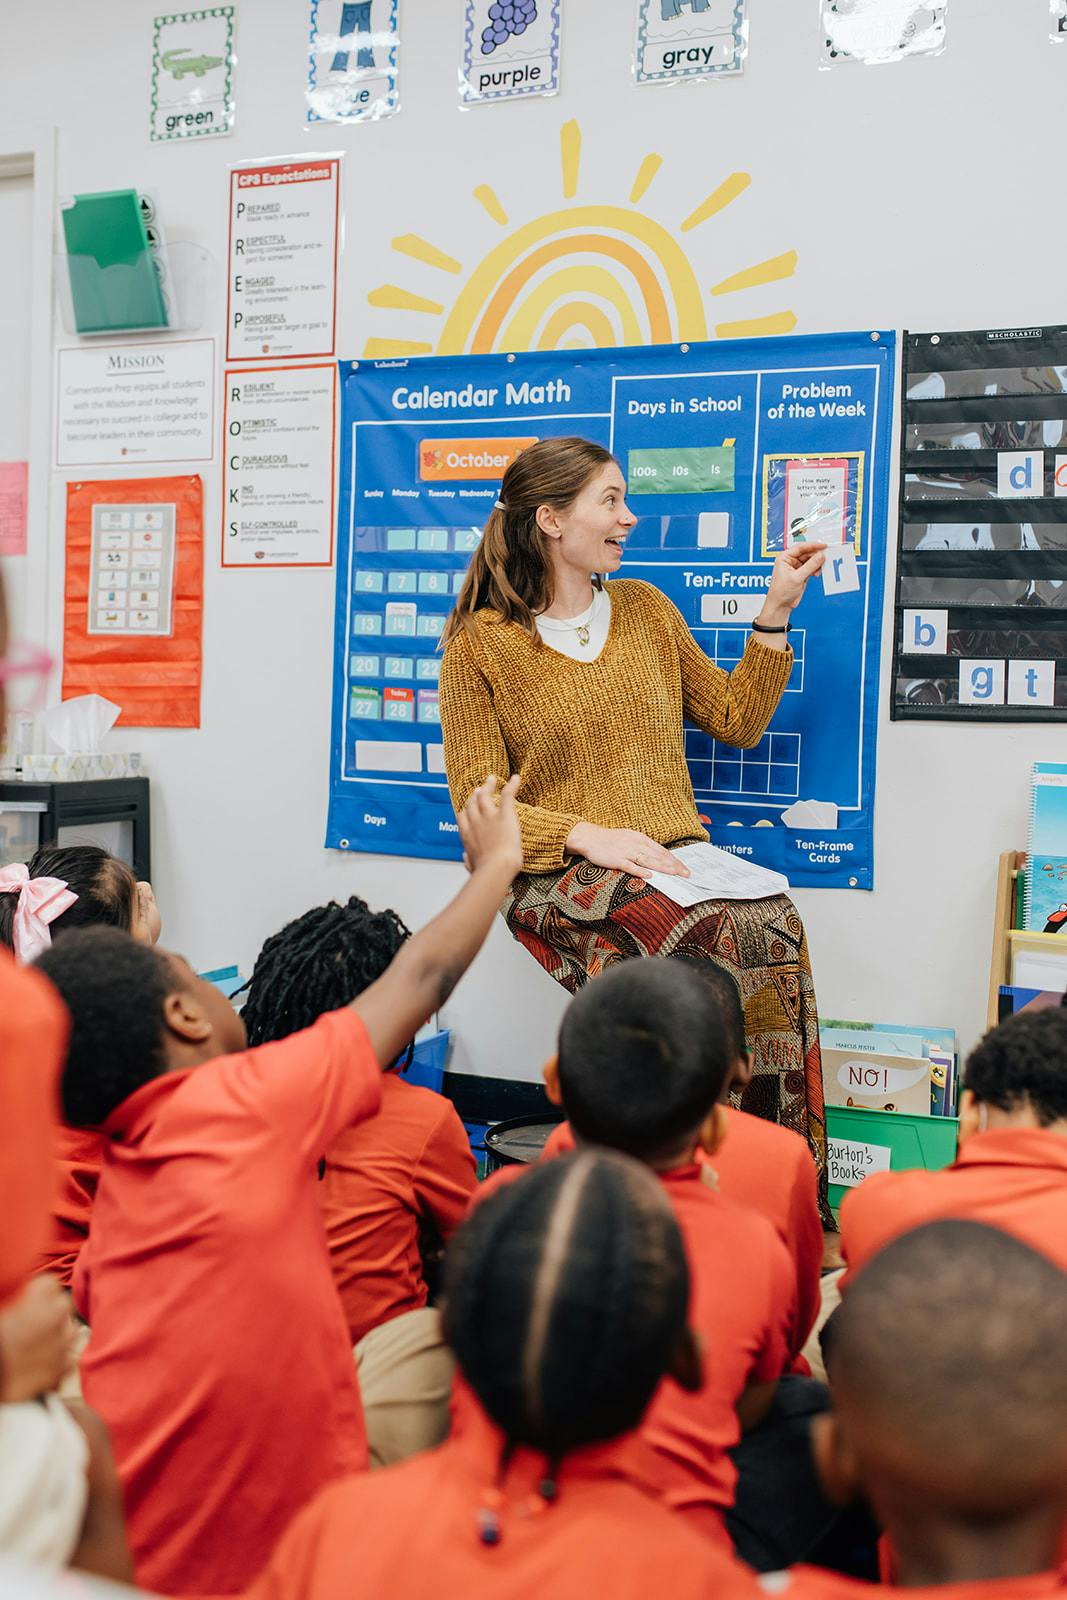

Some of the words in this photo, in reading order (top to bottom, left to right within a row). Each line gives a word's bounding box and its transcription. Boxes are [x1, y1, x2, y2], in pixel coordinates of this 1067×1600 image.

[662, 44, 715, 70] gray
[479, 65, 541, 91] purple
[166, 110, 214, 131] green
[261, 168, 330, 184] Expectations
[237, 202, 245, 219] P
[236, 239, 245, 256] R
[234, 276, 242, 292] E
[234, 312, 243, 328] P
[994, 330, 1040, 338] SCHOLASTIC
[65, 384, 113, 396] Cornerstone
[114, 384, 132, 393] Prep
[134, 382, 159, 392] equips
[160, 380, 170, 389] all
[172, 380, 206, 388] students
[232, 388, 241, 402] R
[392, 384, 499, 410] Calendar
[505, 378, 572, 406] Math
[782, 382, 852, 400] Problem
[73, 402, 90, 410] with
[91, 401, 104, 409] the
[138, 398, 153, 406] and
[154, 396, 199, 407] Knowledge
[628, 400, 666, 418] Days
[670, 398, 684, 414] in
[689, 395, 742, 413] School
[768, 403, 785, 419] of
[788, 402, 816, 418] the
[818, 400, 866, 418] Week
[101, 416, 110, 424] to
[112, 415, 142, 424] succeed
[144, 414, 151, 422] in
[152, 412, 182, 423] college
[182, 412, 198, 420] and
[200, 412, 208, 420] to
[136, 430, 154, 438] their
[229, 421, 242, 436] O
[230, 456, 240, 470] C
[446, 452, 510, 469] October
[632, 467, 657, 477] 100s
[672, 466, 688, 476] 10s
[1009, 457, 1032, 490] d
[230, 488, 239, 503] K
[364, 490, 384, 498] Sunday
[392, 488, 420, 498] Monday
[428, 490, 456, 498] Tuesday
[459, 489, 494, 498] Wednesday
[230, 521, 238, 537] S
[430, 533, 435, 547] 1
[466, 533, 475, 548] 2
[832, 558, 843, 582] r
[364, 574, 373, 589] 6
[398, 574, 406, 589] 7
[428, 575, 438, 590] 8
[722, 599, 738, 616] 10
[360, 617, 374, 632] 13
[392, 616, 406, 631] 14
[424, 618, 438, 632] 15
[914, 615, 936, 646] b
[356, 658, 374, 673] 20
[391, 660, 406, 674] 21
[422, 661, 439, 676] 22
[971, 666, 994, 698] g
[1024, 668, 1038, 698] t
[390, 689, 408, 698] Today
[356, 700, 372, 715] 27
[390, 703, 406, 717] 28
[364, 814, 386, 827] Days
[795, 839, 854, 851] Ten-Frame
[808, 853, 841, 864] Cards
[836, 1042, 857, 1050] MARCUS
[848, 1066, 888, 1092] NO!
[826, 1142, 874, 1165] Burton's
[832, 1162, 866, 1180] Books
